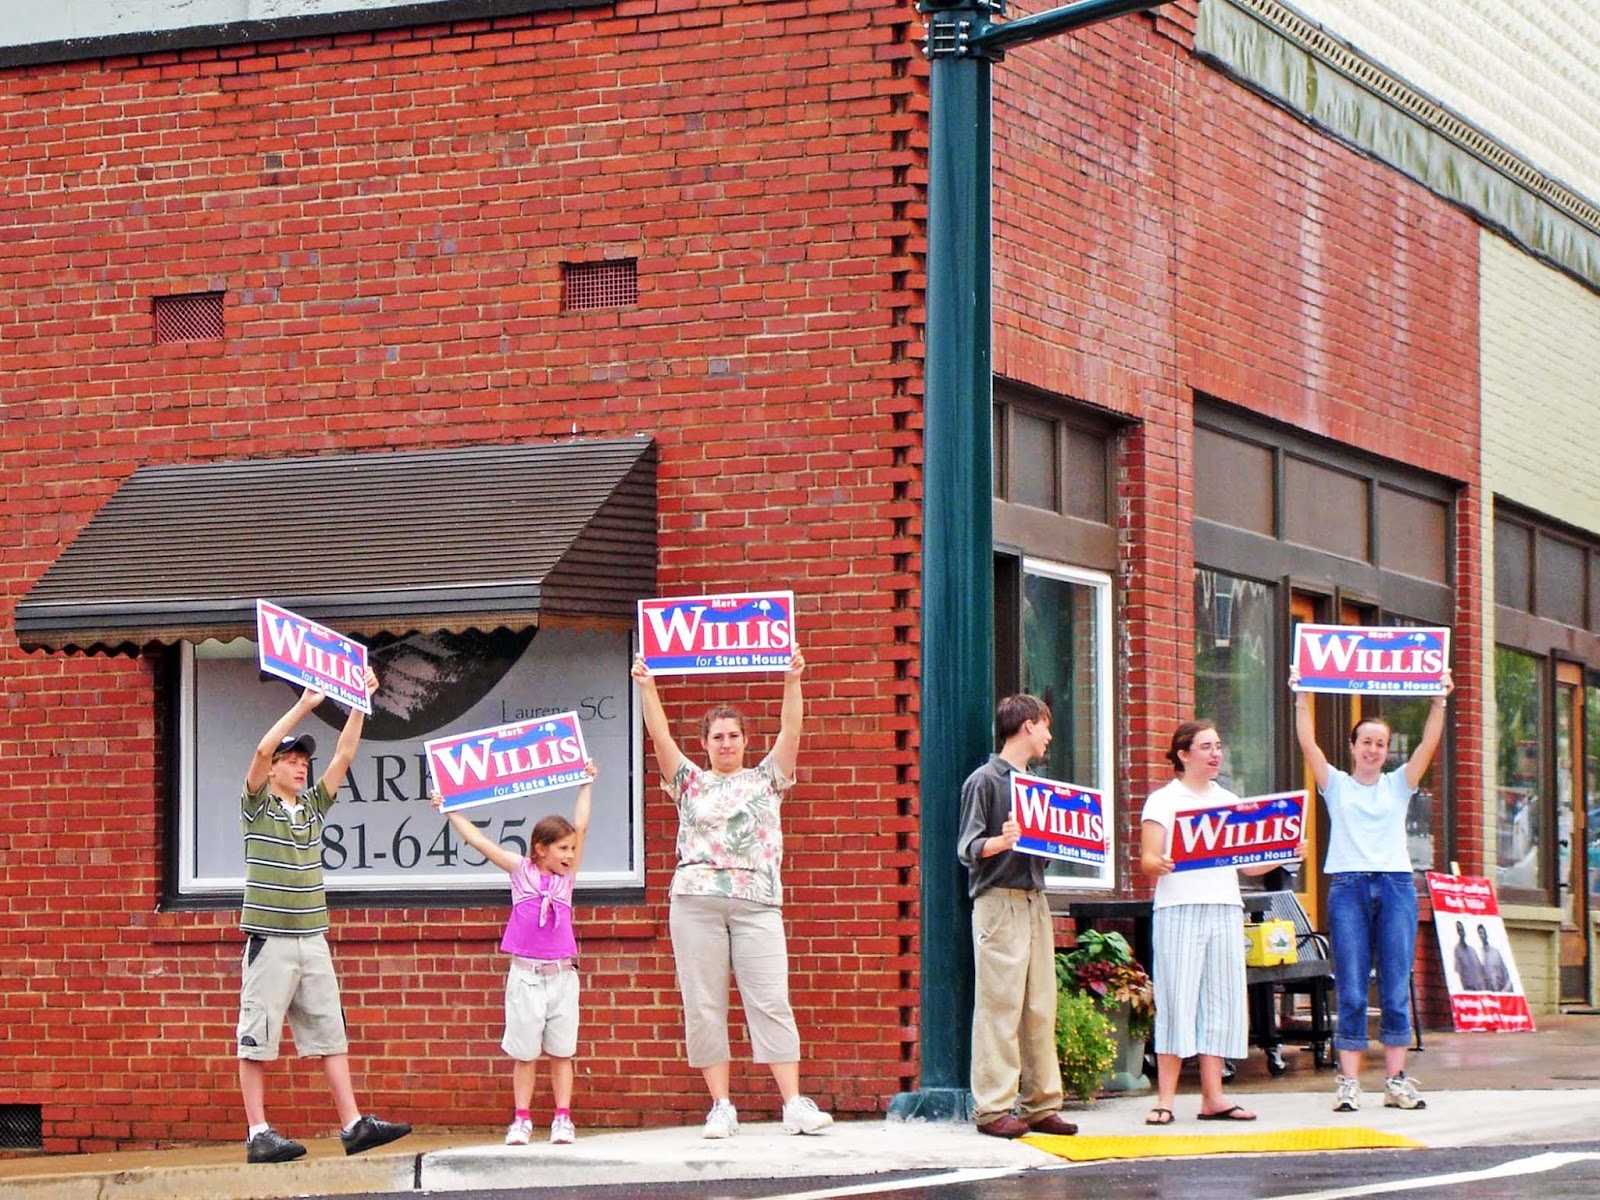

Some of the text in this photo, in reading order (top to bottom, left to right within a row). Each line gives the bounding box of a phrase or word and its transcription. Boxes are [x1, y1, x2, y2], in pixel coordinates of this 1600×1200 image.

[711, 598, 737, 608] Mark
[643, 605, 790, 653] WILLIS
[262, 610, 365, 692] WILLIS
[696, 654, 790, 667] for State House
[1302, 632, 1443, 674] WILLIS
[1348, 679, 1364, 690] for
[1367, 680, 1400, 690] State
[578, 695, 617, 721] SC
[497, 727, 524, 739] Mark
[432, 735, 581, 786] WILLIS
[493, 770, 587, 797] for State House
[1014, 783, 1104, 843] WILLIS
[1176, 810, 1301, 854] WILLIS
[1058, 844, 1079, 858] State
[1232, 852, 1262, 865] State
[1264, 849, 1293, 861] Hous
